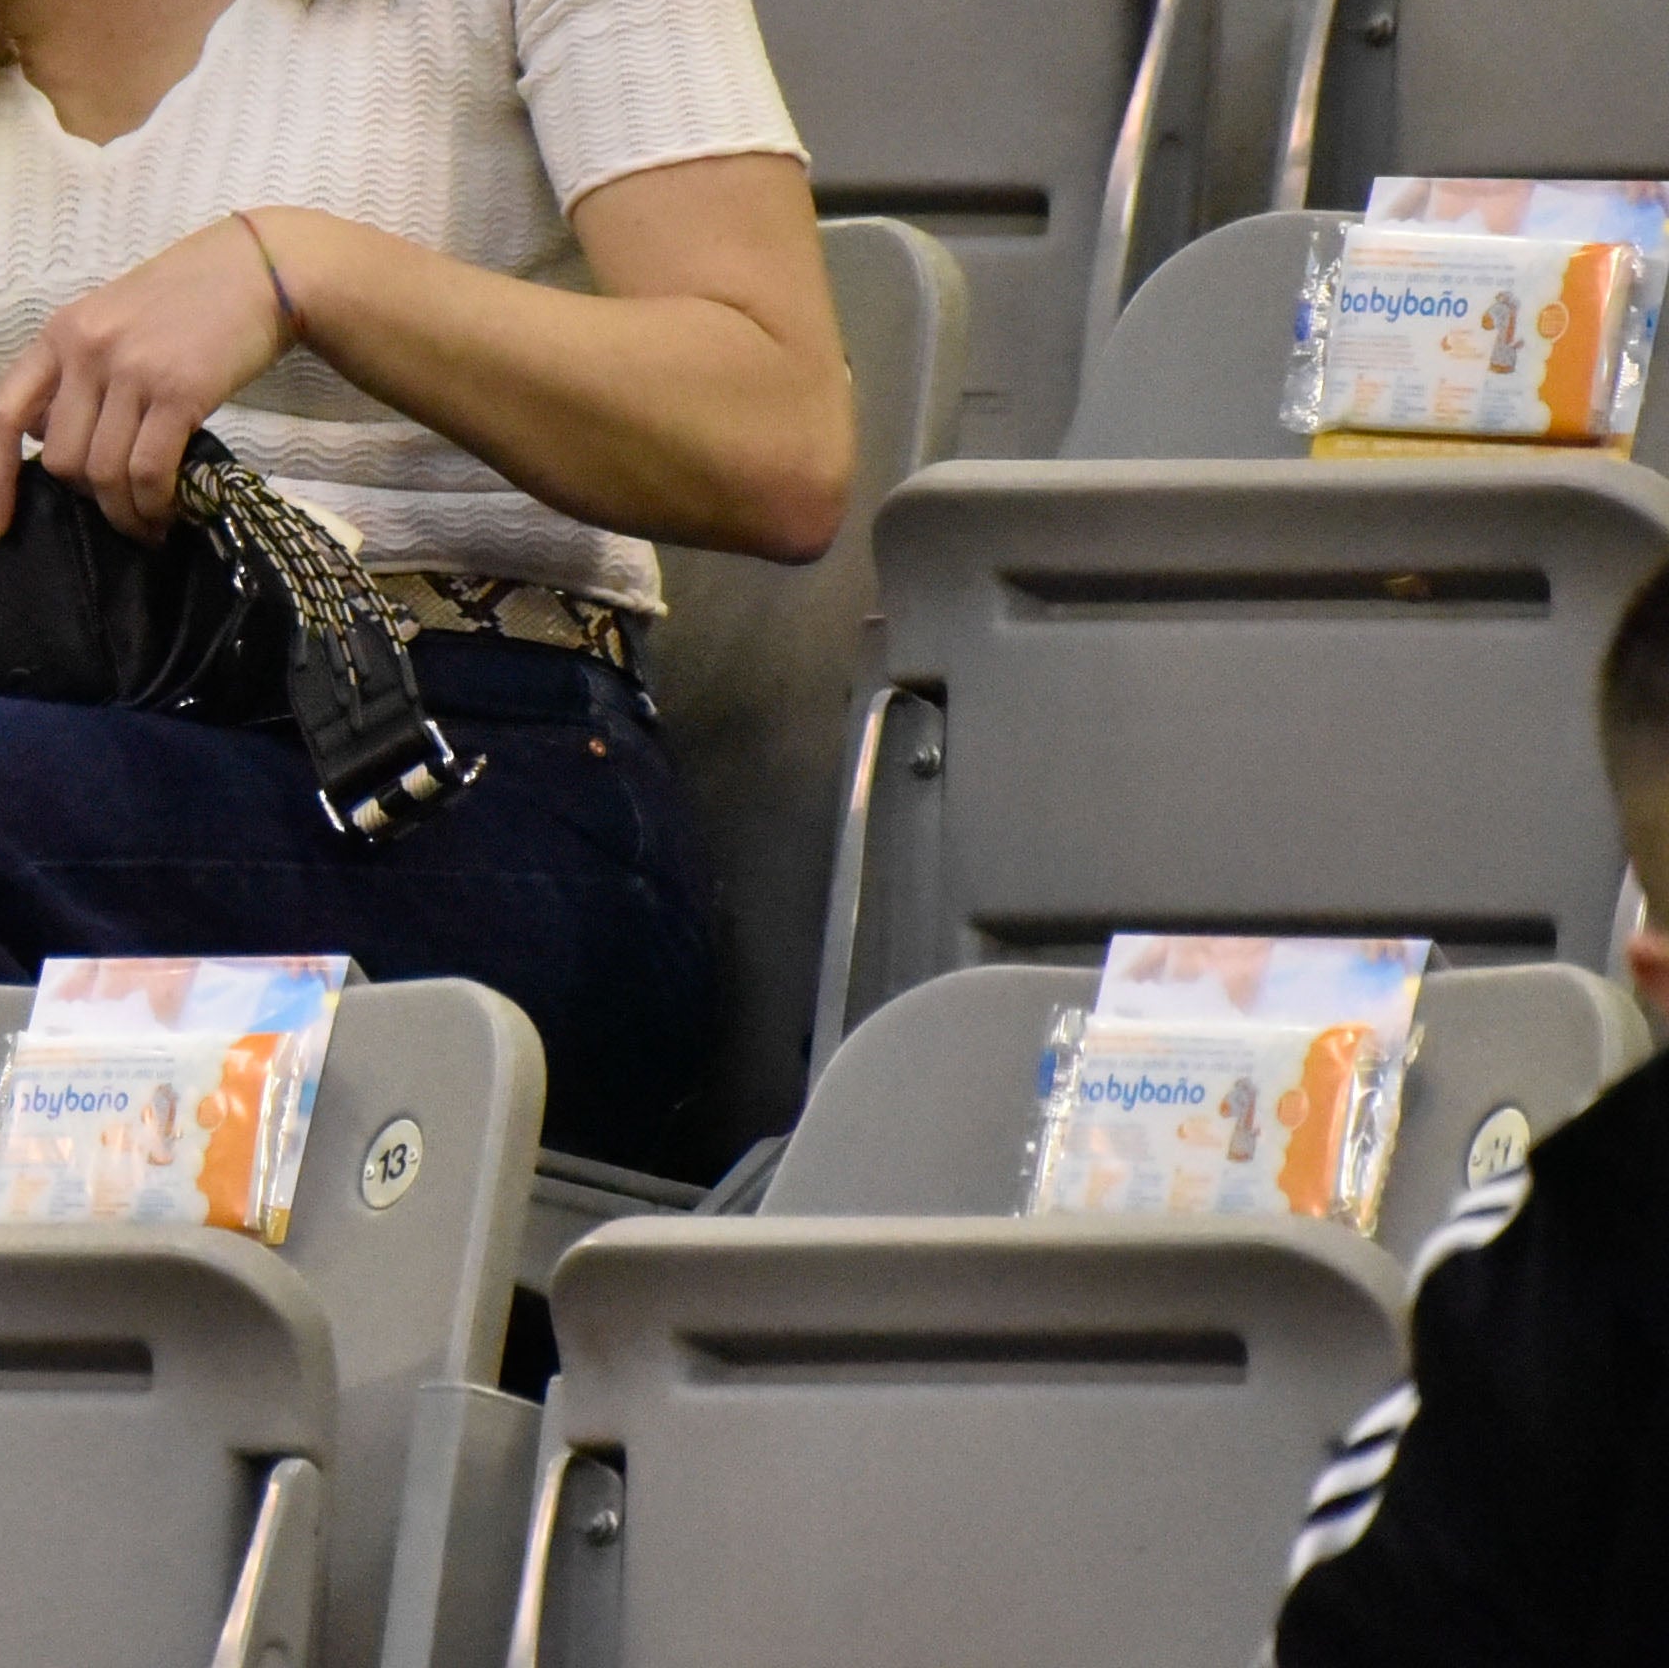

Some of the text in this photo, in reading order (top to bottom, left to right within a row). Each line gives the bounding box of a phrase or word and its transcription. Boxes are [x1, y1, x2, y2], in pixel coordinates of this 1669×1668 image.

[1340, 285, 1469, 323] babybaño
[9, 1083, 129, 1120] bybaño
[377, 1143, 408, 1183] 13
